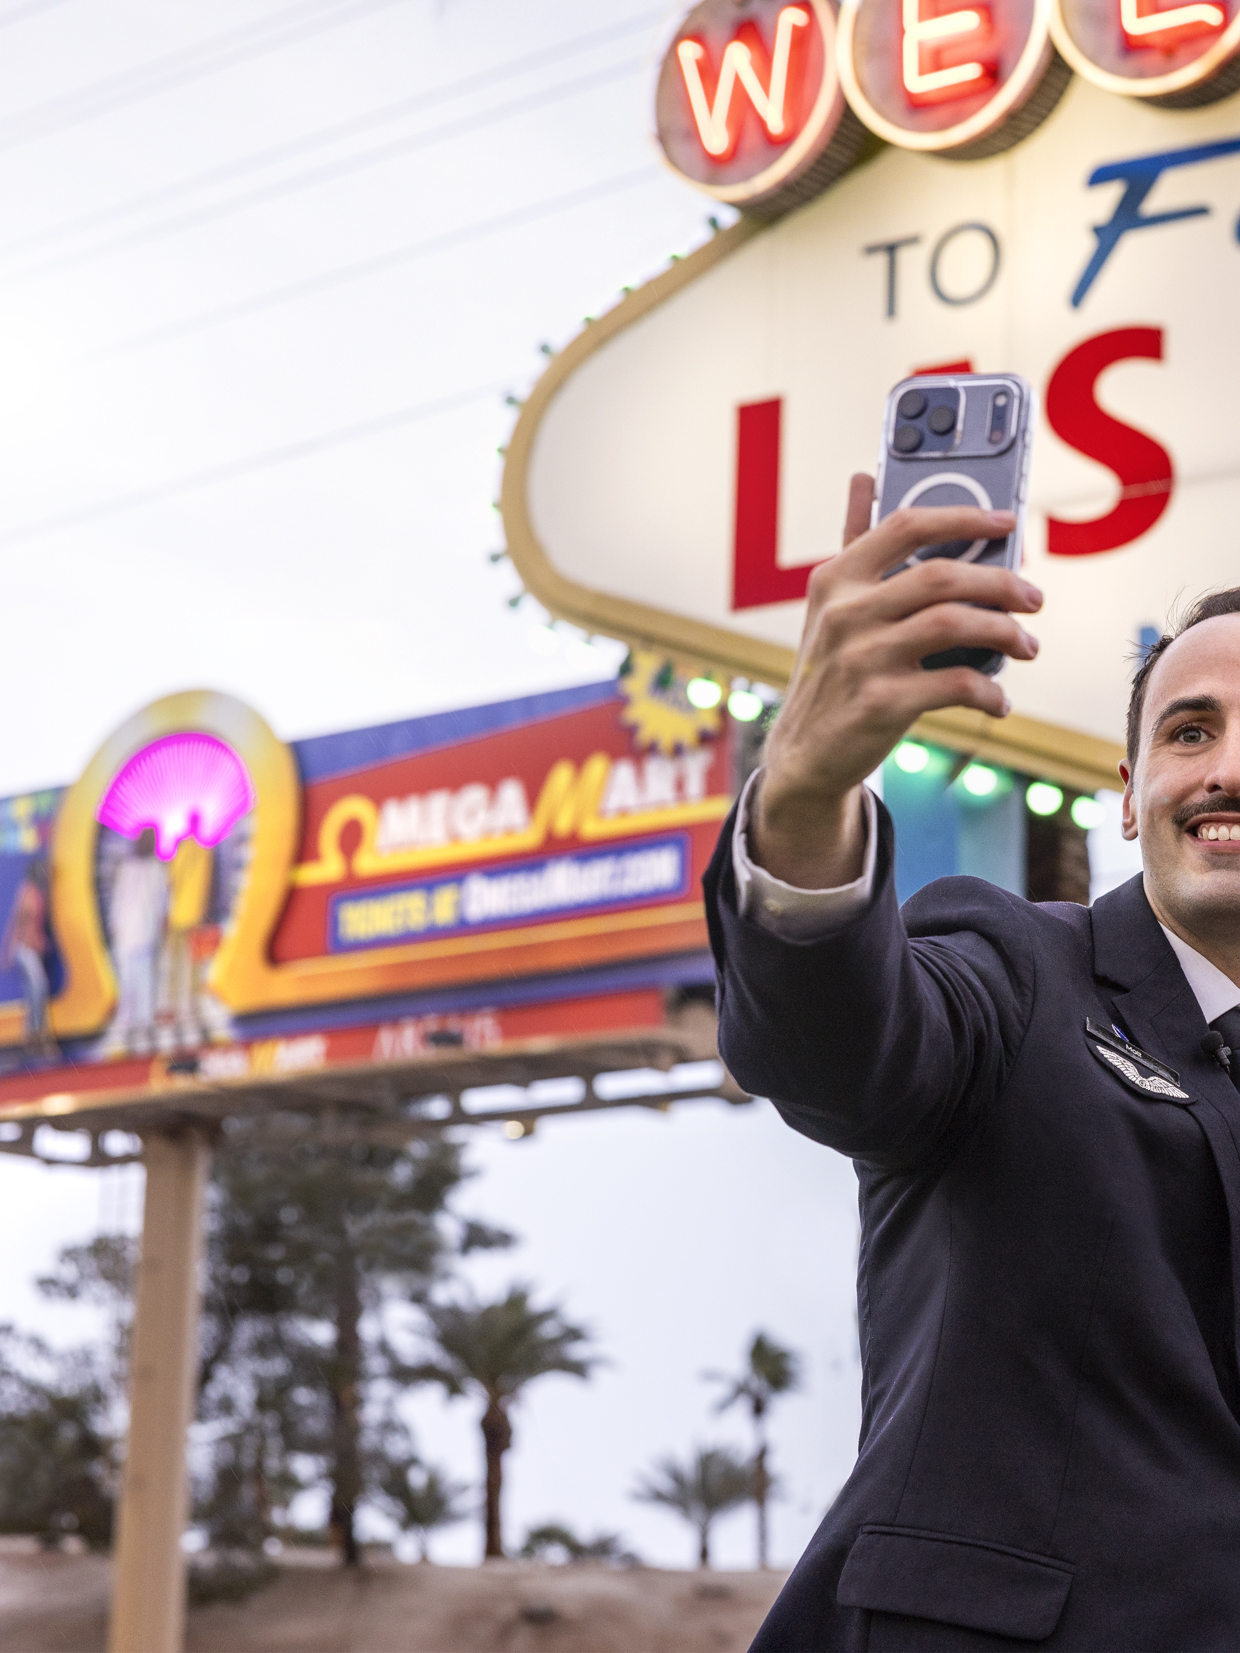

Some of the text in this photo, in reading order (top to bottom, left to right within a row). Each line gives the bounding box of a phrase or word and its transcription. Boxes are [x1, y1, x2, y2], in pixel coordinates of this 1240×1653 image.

[862, 221, 1004, 321] TO
[731, 324, 1177, 613] LS
[536, 750, 715, 840] MART
